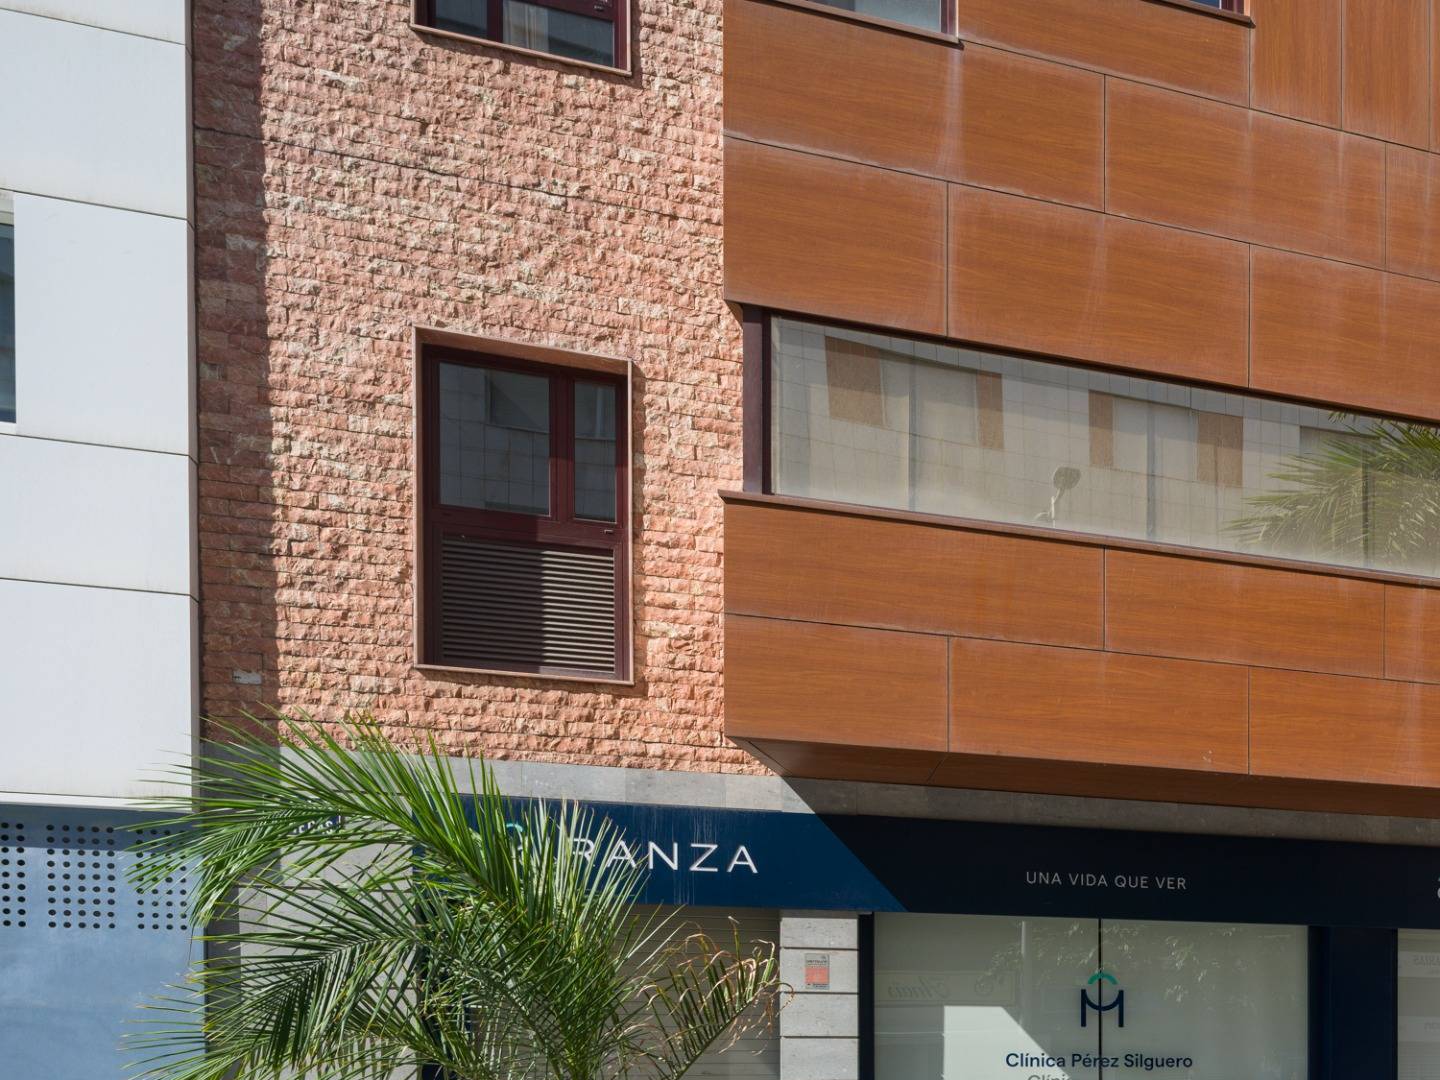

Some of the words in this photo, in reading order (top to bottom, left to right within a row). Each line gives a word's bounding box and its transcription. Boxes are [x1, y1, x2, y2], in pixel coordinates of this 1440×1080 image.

[1026, 871, 1062, 886] UNA
[1068, 872, 1108, 888] VIDA
[1114, 874, 1149, 890] QUE
[1155, 875, 1188, 891] VER
[1006, 1052, 1066, 1068] Clínica
[1071, 1052, 1119, 1068] Pérez
[1124, 1053, 1193, 1071] Silguero
